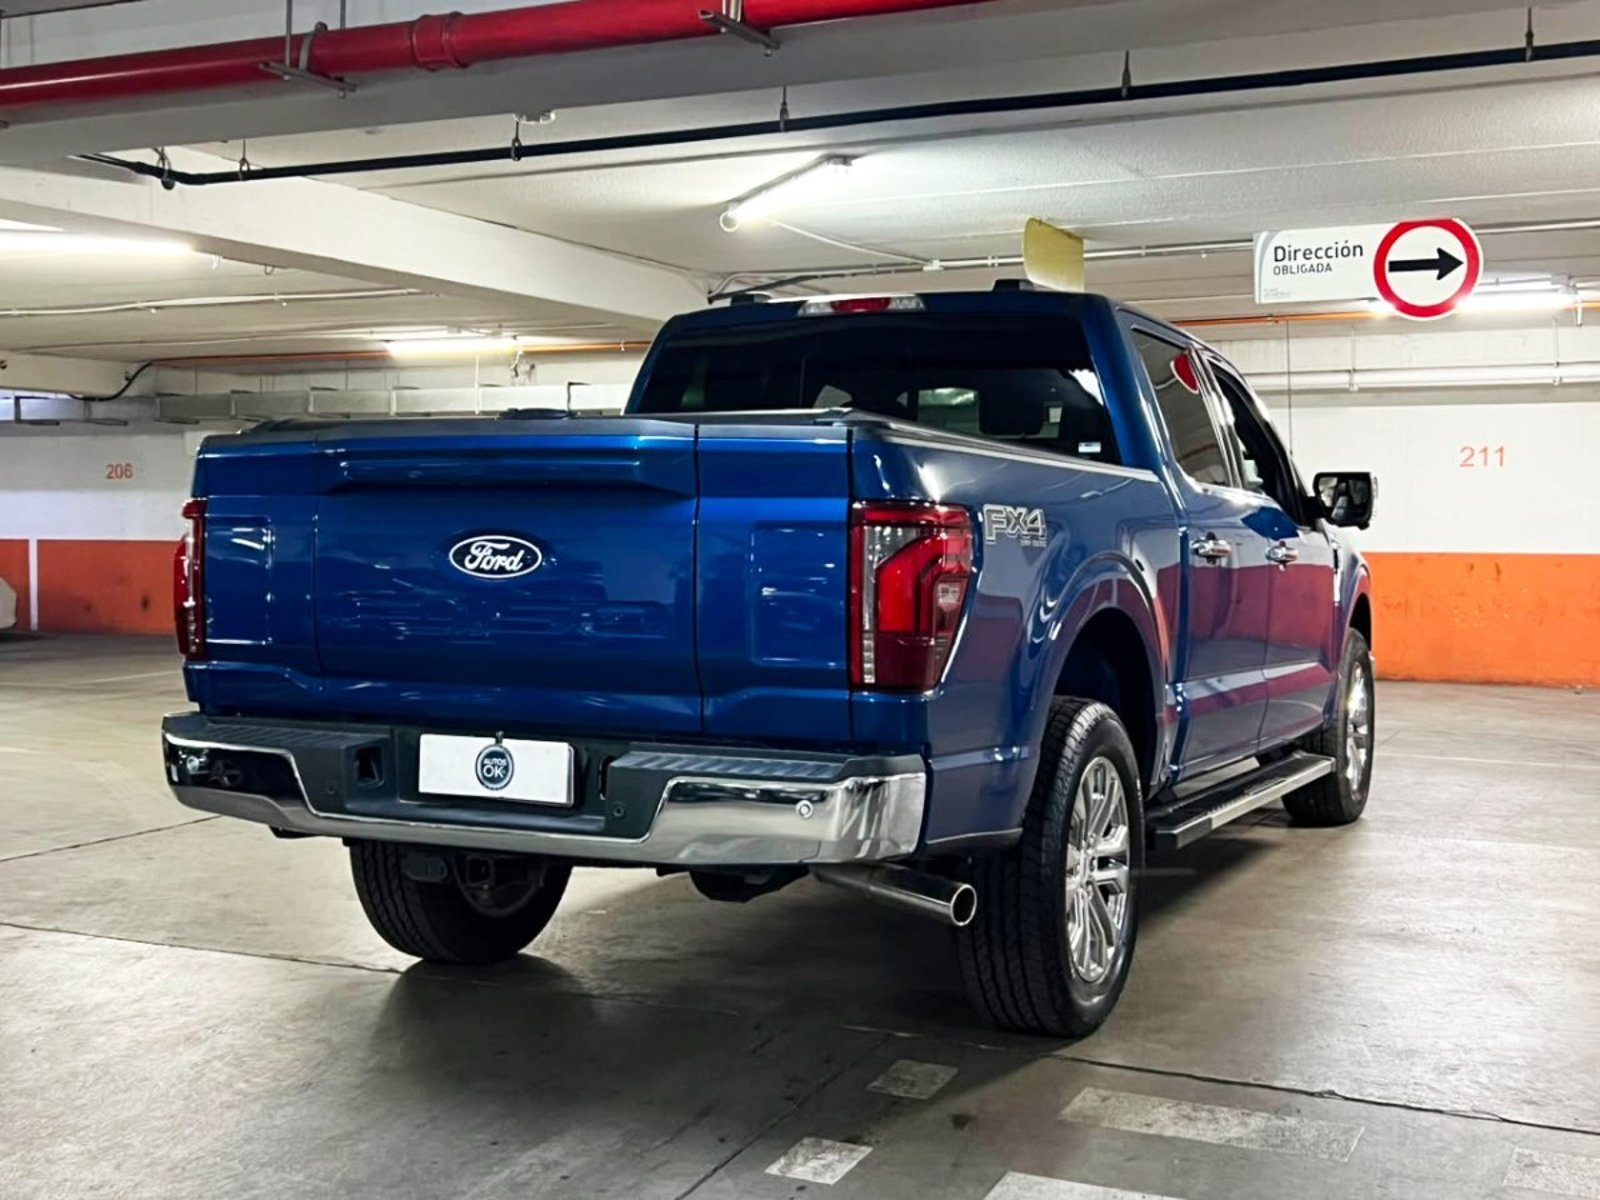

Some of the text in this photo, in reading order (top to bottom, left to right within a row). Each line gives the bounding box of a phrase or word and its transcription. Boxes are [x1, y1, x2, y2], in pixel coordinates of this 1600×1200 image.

[1273, 239, 1364, 263] Dirección
[1273, 262, 1333, 276] OBLIGADA
[1459, 445, 1505, 467] 211
[105, 463, 133, 480] 206
[983, 503, 1047, 545] FX4
[464, 540, 525, 571] Ford
[483, 757, 507, 766] AUTOS
[483, 764, 504, 778] OK
